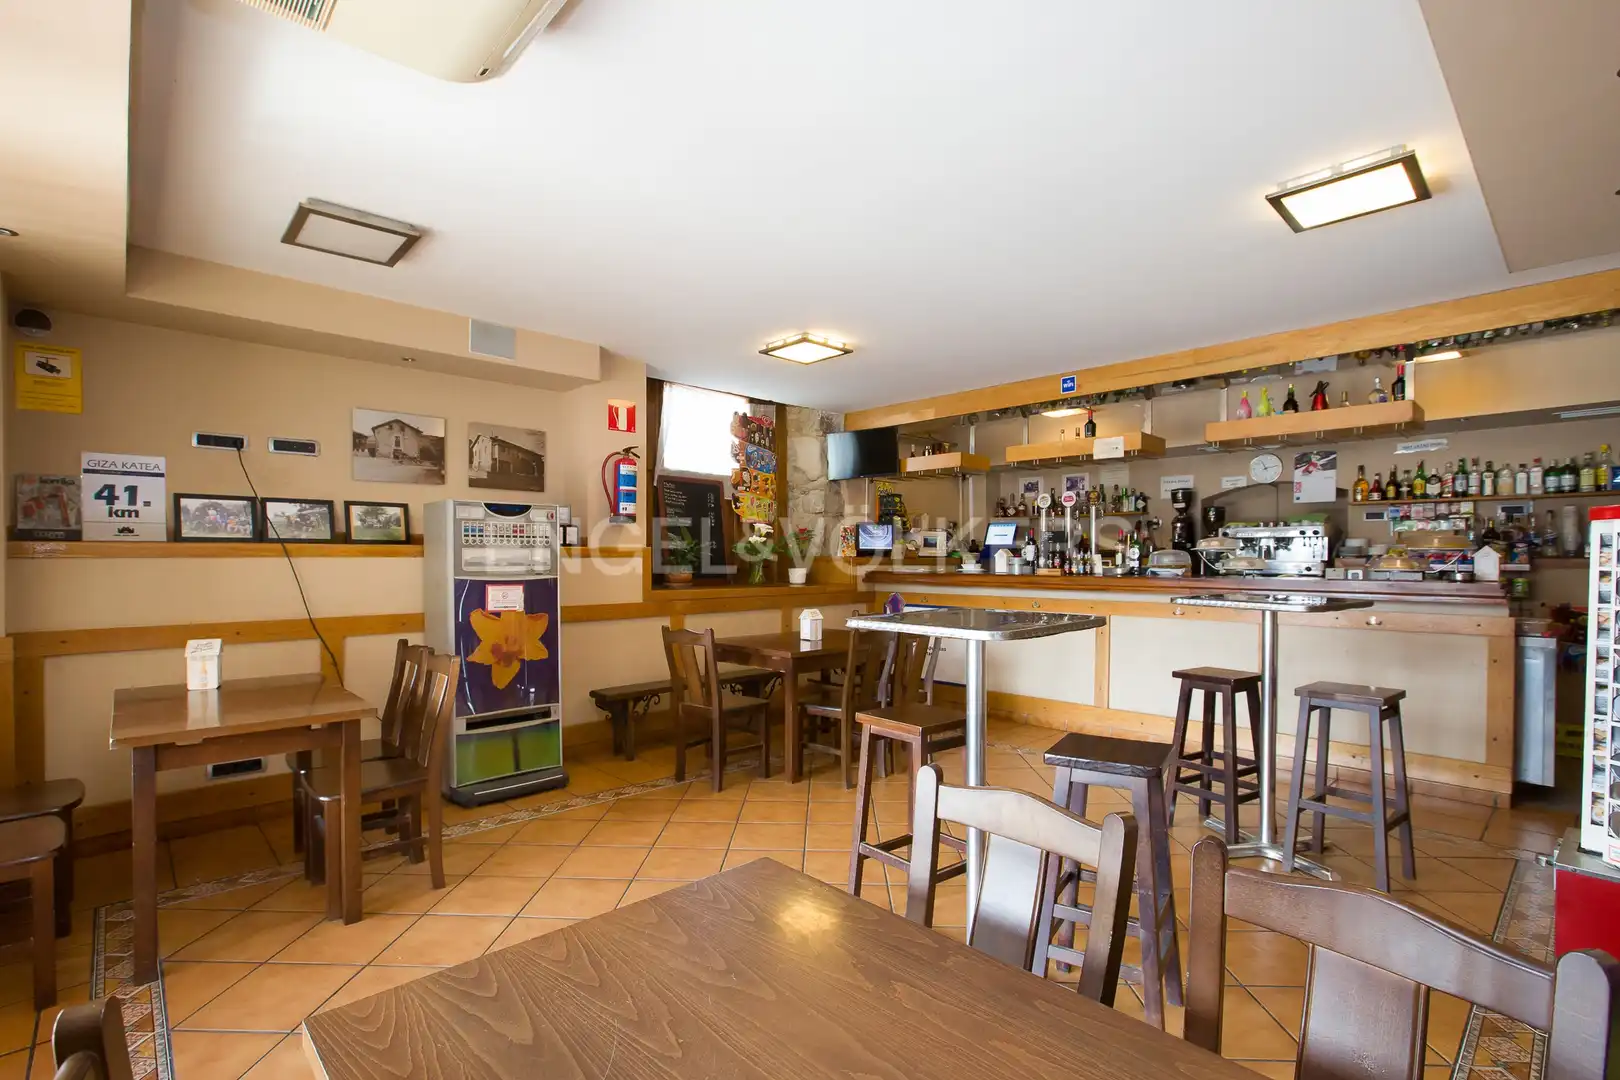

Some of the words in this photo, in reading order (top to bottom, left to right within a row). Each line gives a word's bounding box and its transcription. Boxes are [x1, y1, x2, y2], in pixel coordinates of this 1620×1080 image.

[87, 459, 117, 469] GIZA
[121, 461, 161, 471] KATEA
[108, 506, 139, 518] km
